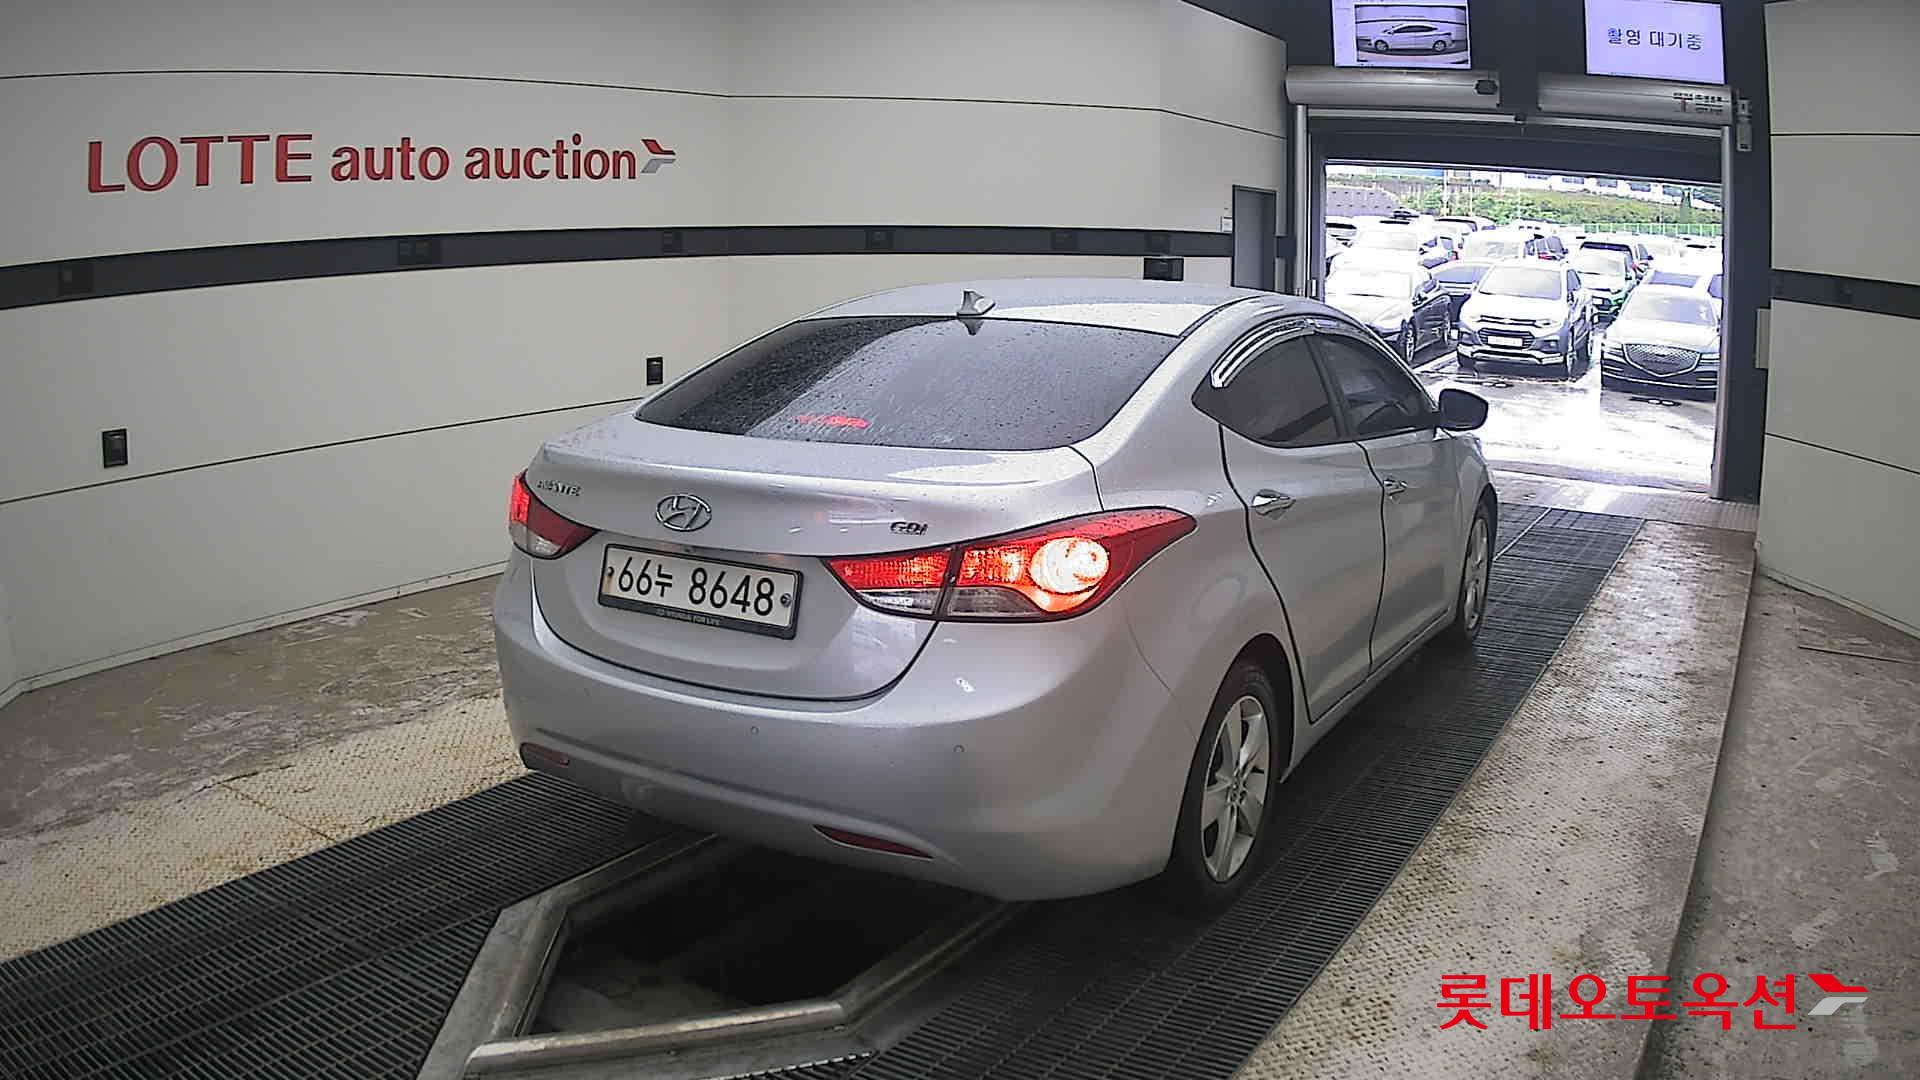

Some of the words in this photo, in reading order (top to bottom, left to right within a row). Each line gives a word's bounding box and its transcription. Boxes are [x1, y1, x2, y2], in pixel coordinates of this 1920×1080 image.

[1649, 31, 1702, 51] 대기중
[88, 133, 313, 193] LOTTE
[330, 137, 450, 182] auto
[463, 133, 638, 181] auction
[618, 556, 673, 598] 66누
[688, 567, 775, 616] 8648
